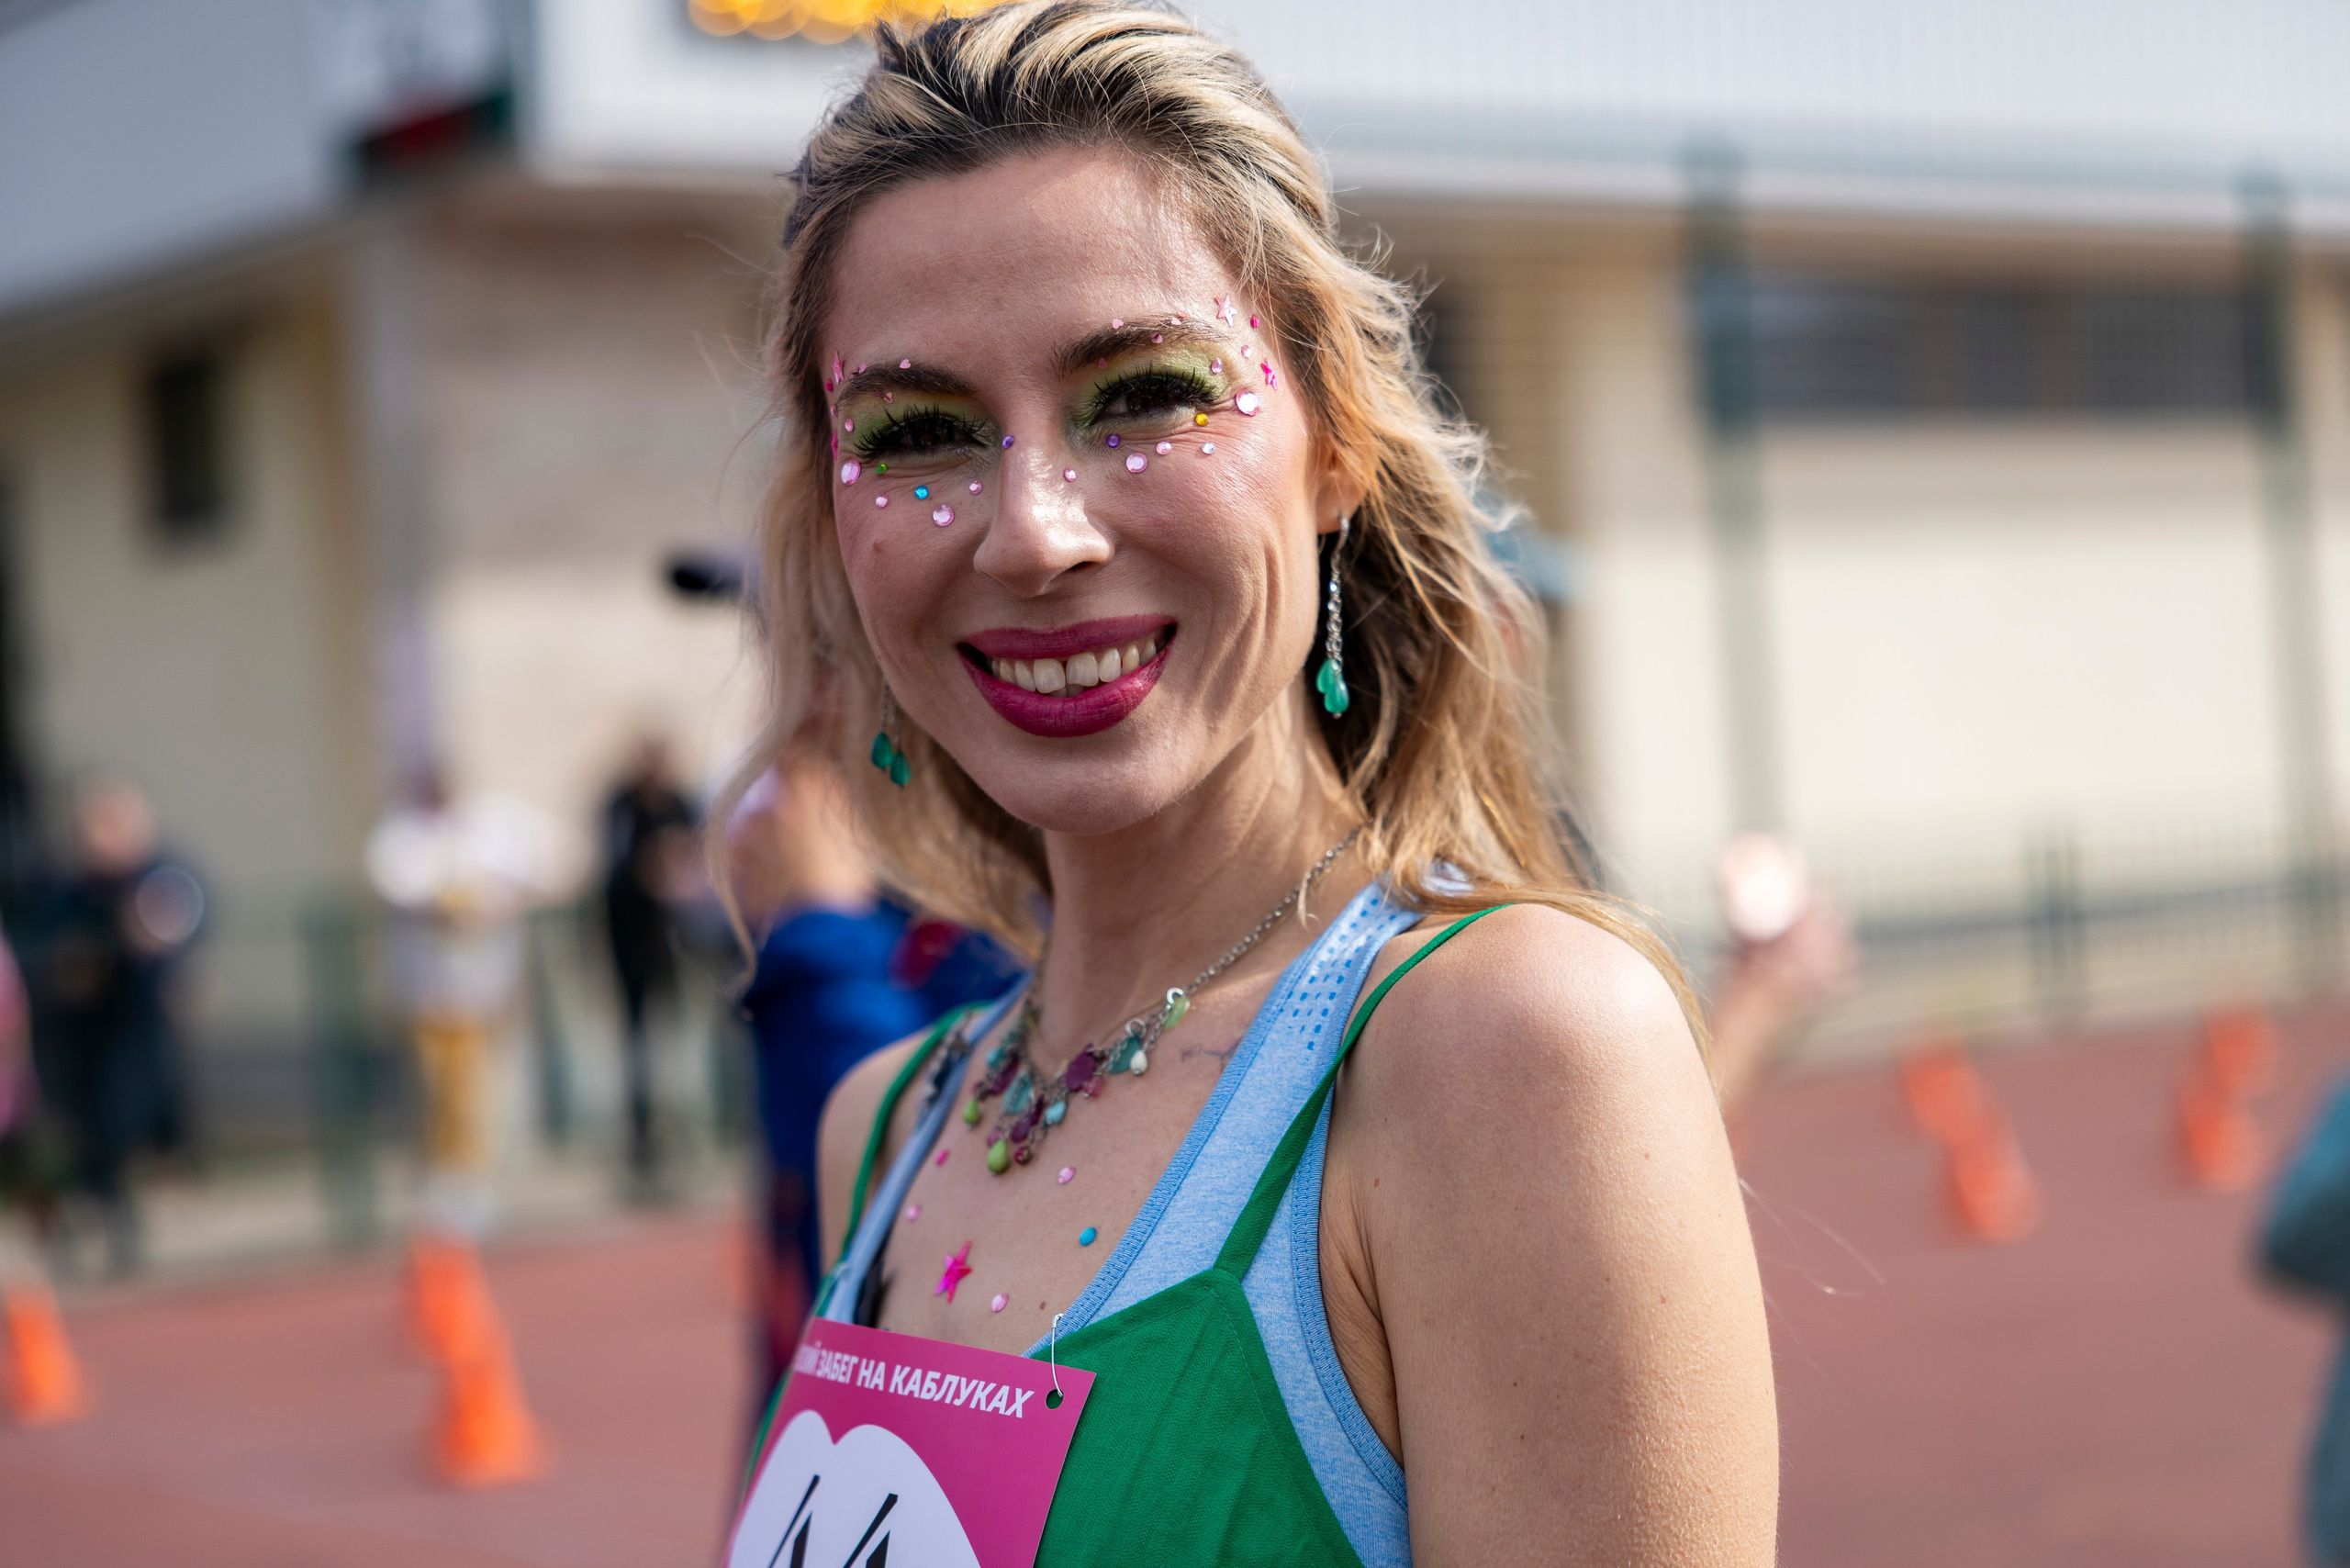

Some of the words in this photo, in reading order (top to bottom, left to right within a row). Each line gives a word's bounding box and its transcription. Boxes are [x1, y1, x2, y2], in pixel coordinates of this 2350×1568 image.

[815, 1349, 859, 1384] ЗАБЕГ
[856, 1358, 886, 1392] НА
[888, 1364, 1035, 1419] КАБЛУКАХ
